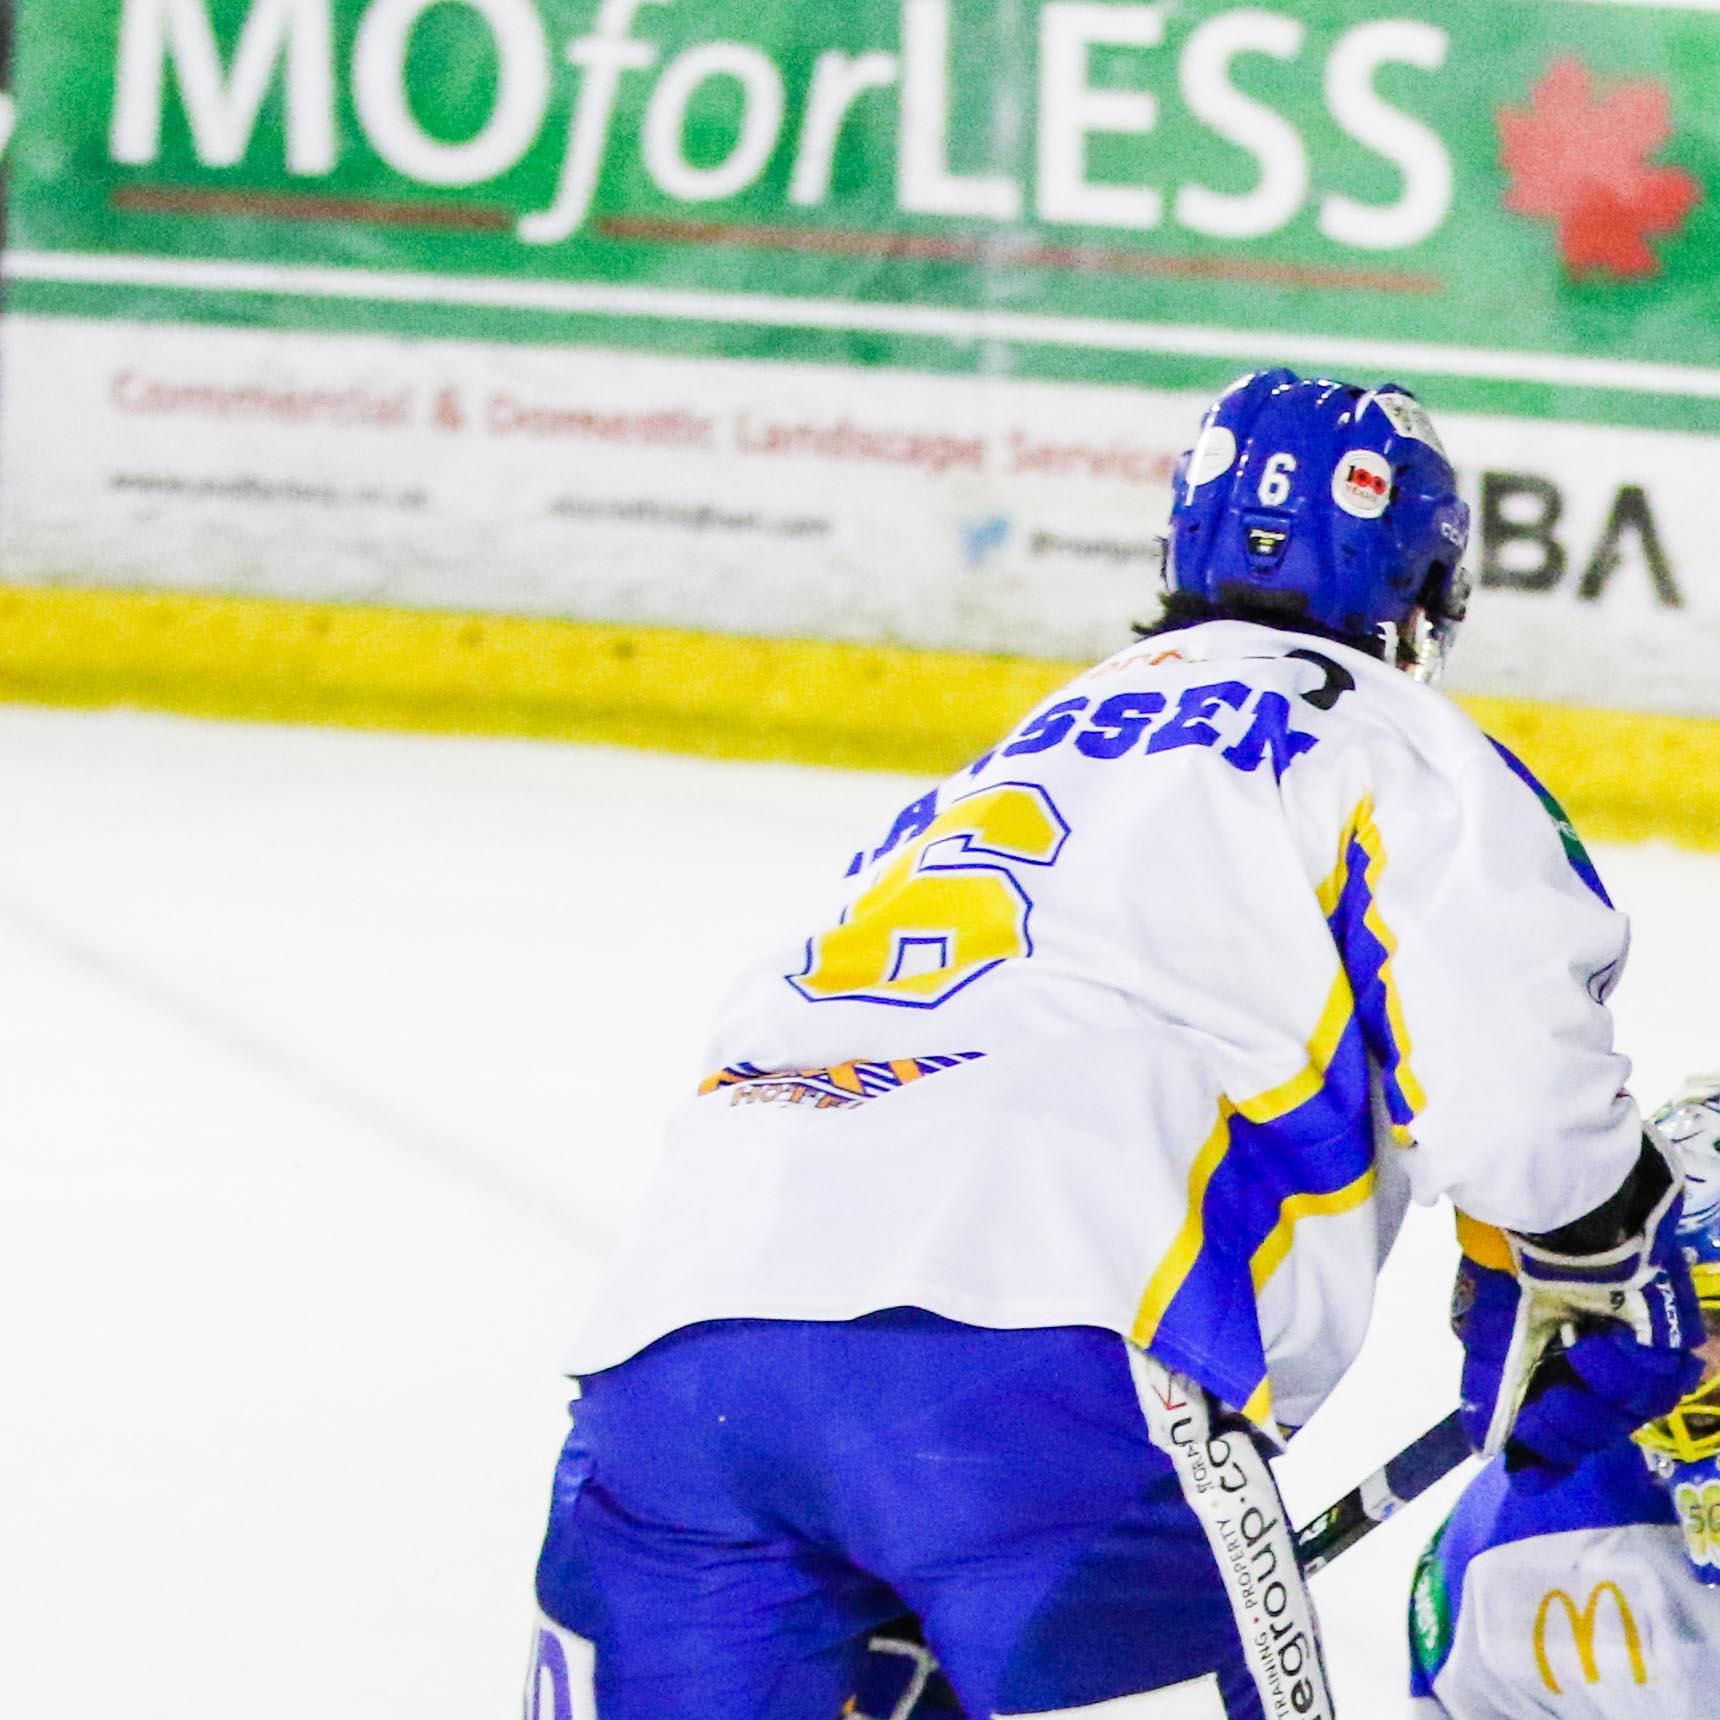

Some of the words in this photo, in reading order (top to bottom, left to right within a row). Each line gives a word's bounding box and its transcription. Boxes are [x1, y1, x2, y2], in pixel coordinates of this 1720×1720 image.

[1257, 452, 1297, 507] 6
[784, 780, 1073, 1010] 6
[1215, 1518, 1258, 1611] PROPERTY
[1252, 1635, 1291, 1720] TRAINING
